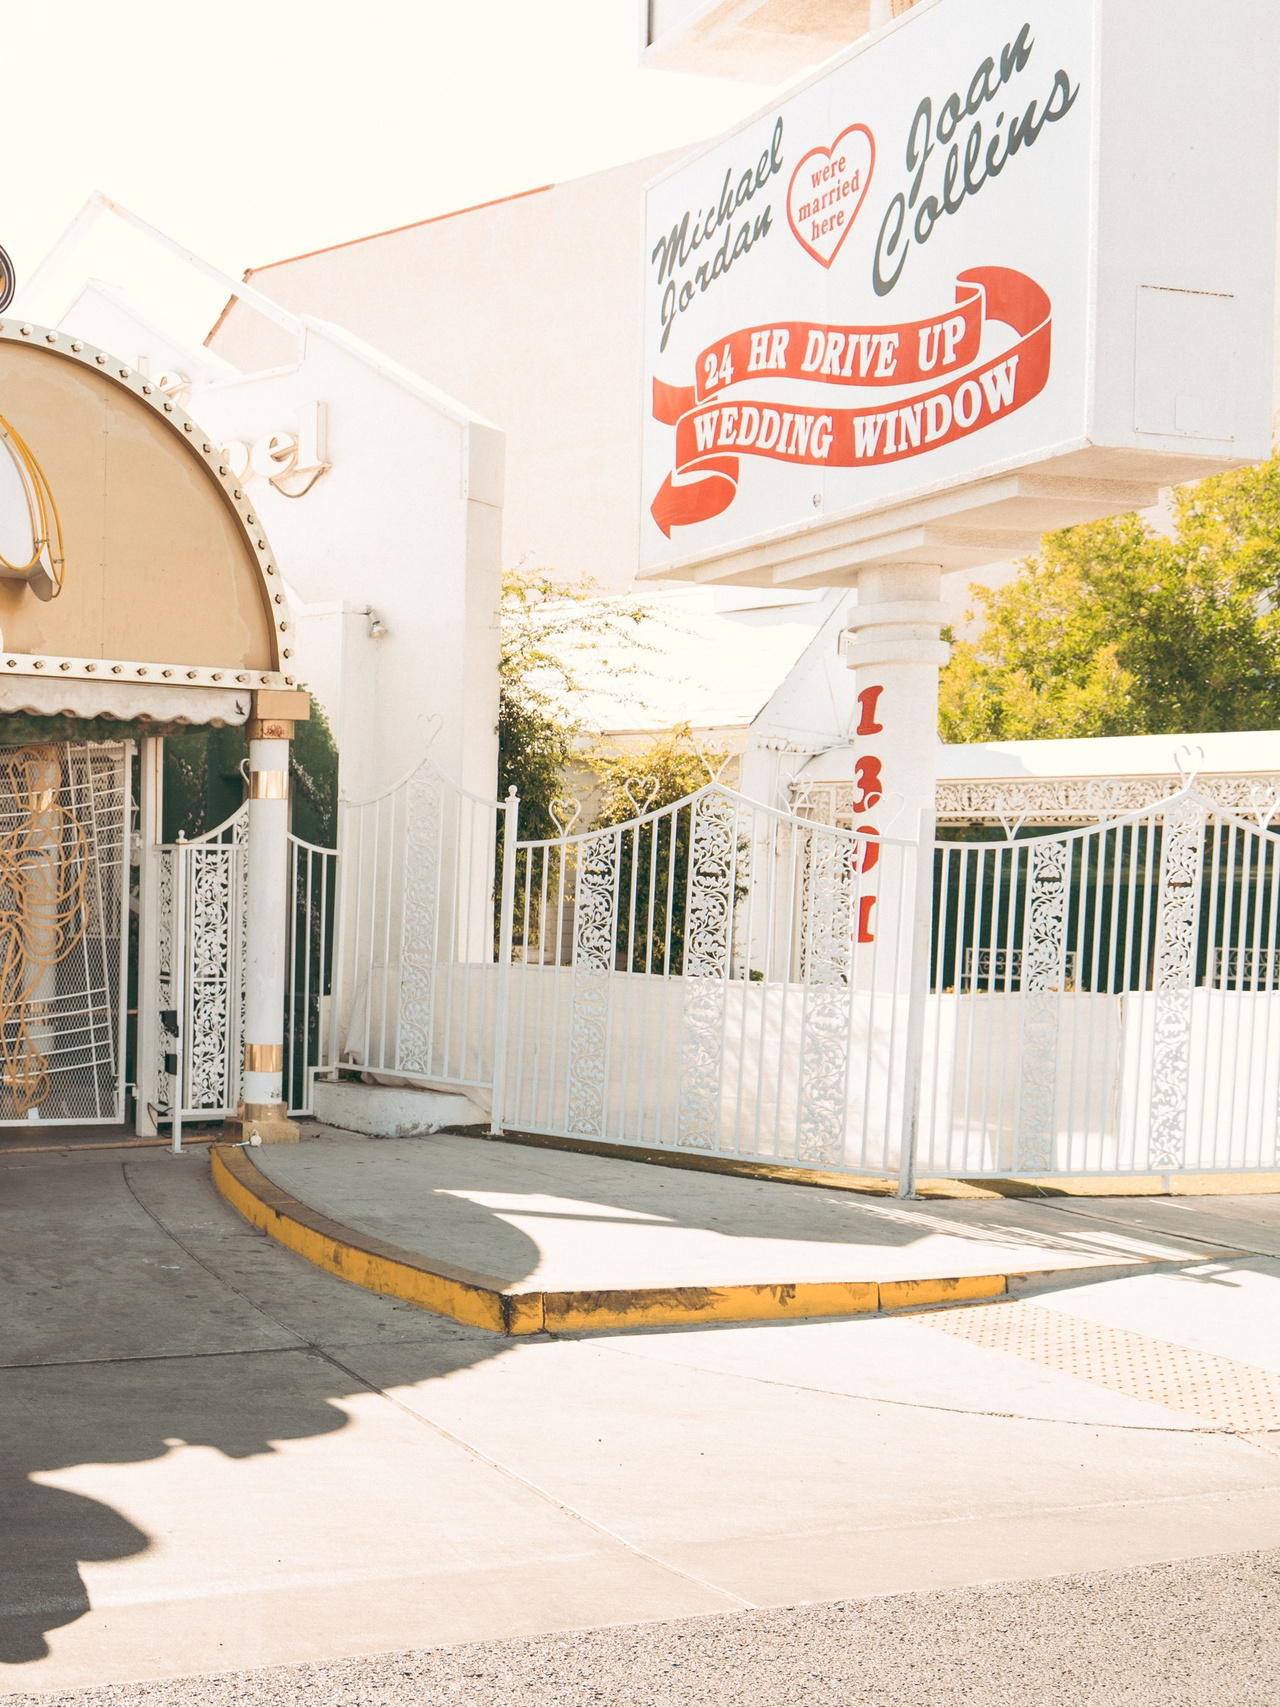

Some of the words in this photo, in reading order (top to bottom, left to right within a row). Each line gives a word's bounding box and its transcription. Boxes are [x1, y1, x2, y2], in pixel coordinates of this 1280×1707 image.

[906, 22, 1035, 210] Joan
[651, 117, 784, 285] Michael
[799, 168, 860, 221] married
[811, 156, 846, 188] were
[872, 69, 1081, 297] Collins
[811, 209, 845, 241] here
[660, 205, 773, 353] Jordan
[704, 348, 734, 390] 24
[747, 330, 789, 373] HR
[801, 328, 899, 379] DRIVE
[917, 316, 967, 372] UP
[693, 412, 834, 459] WEDDING
[853, 354, 1021, 459] WINDOW
